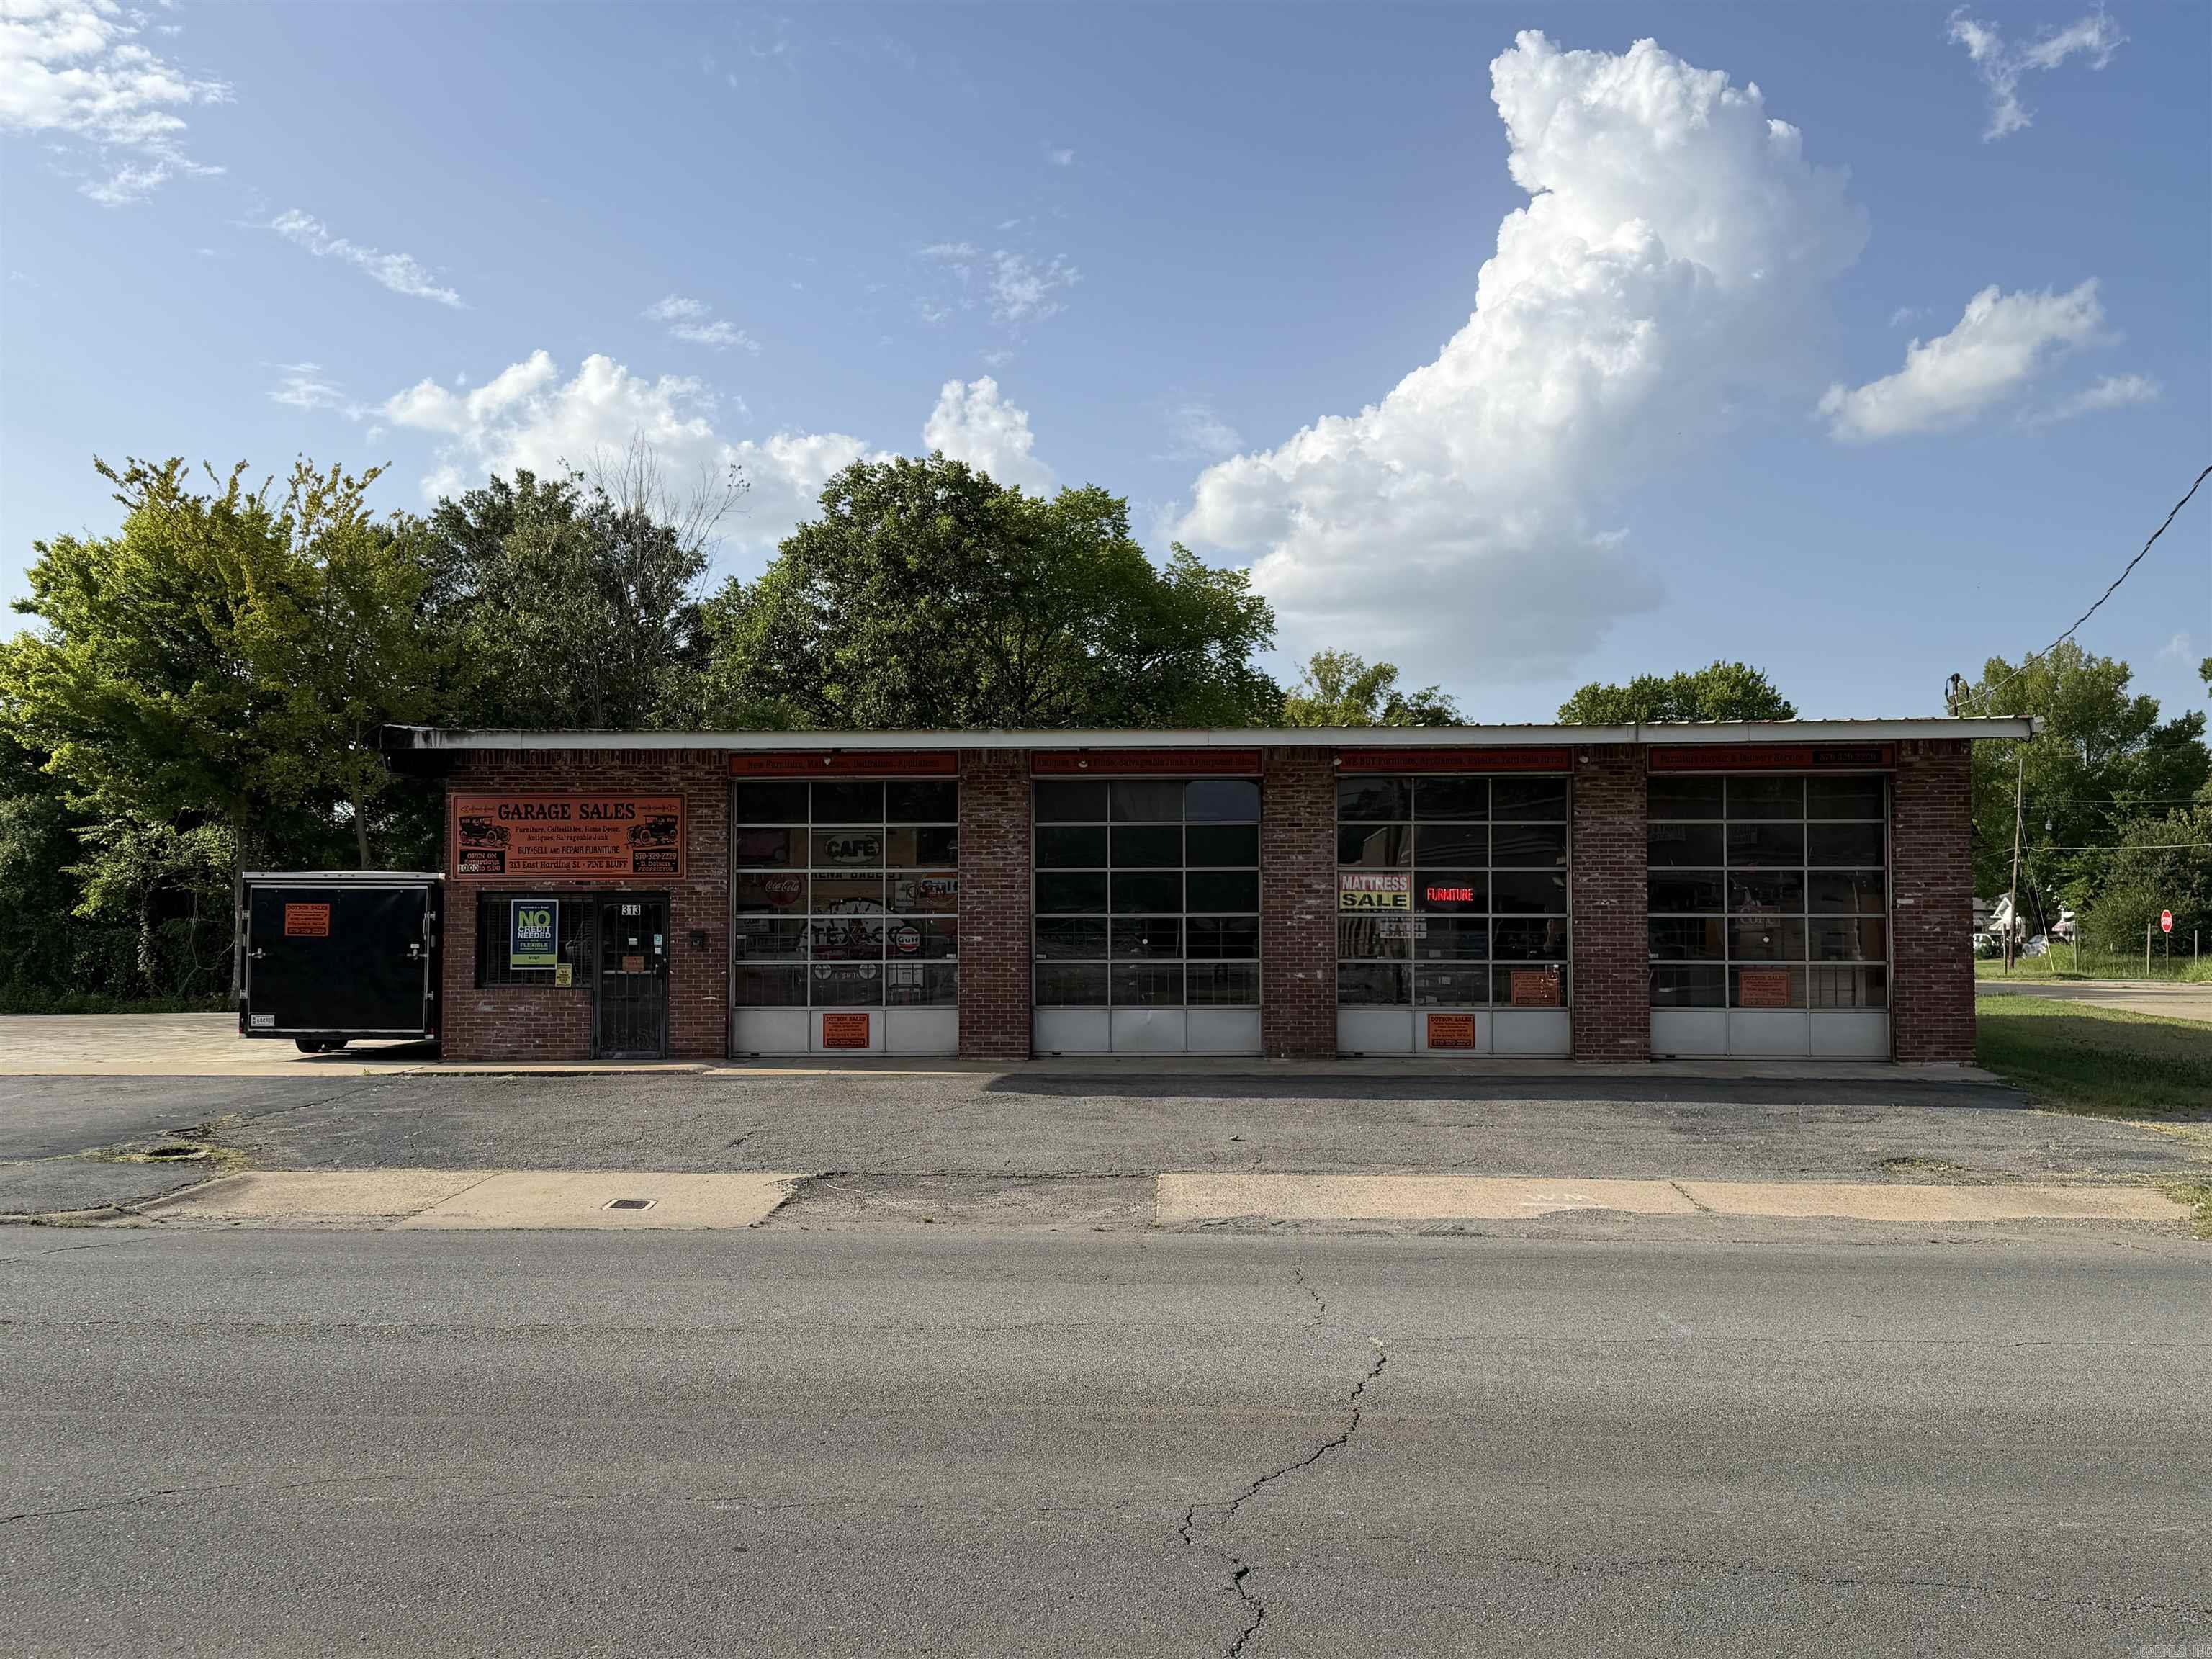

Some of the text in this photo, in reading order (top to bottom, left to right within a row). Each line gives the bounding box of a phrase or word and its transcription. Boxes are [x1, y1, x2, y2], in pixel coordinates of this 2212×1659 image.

[498, 803, 636, 820] GARAGE SALES
[540, 860, 571, 871] Harding
[1342, 876, 1407, 891] MATTRESS
[1342, 894, 1407, 907] SALE
[1427, 887, 1474, 902] FURNITURE
[622, 905, 639, 914] 313
[518, 910, 551, 926] NO
